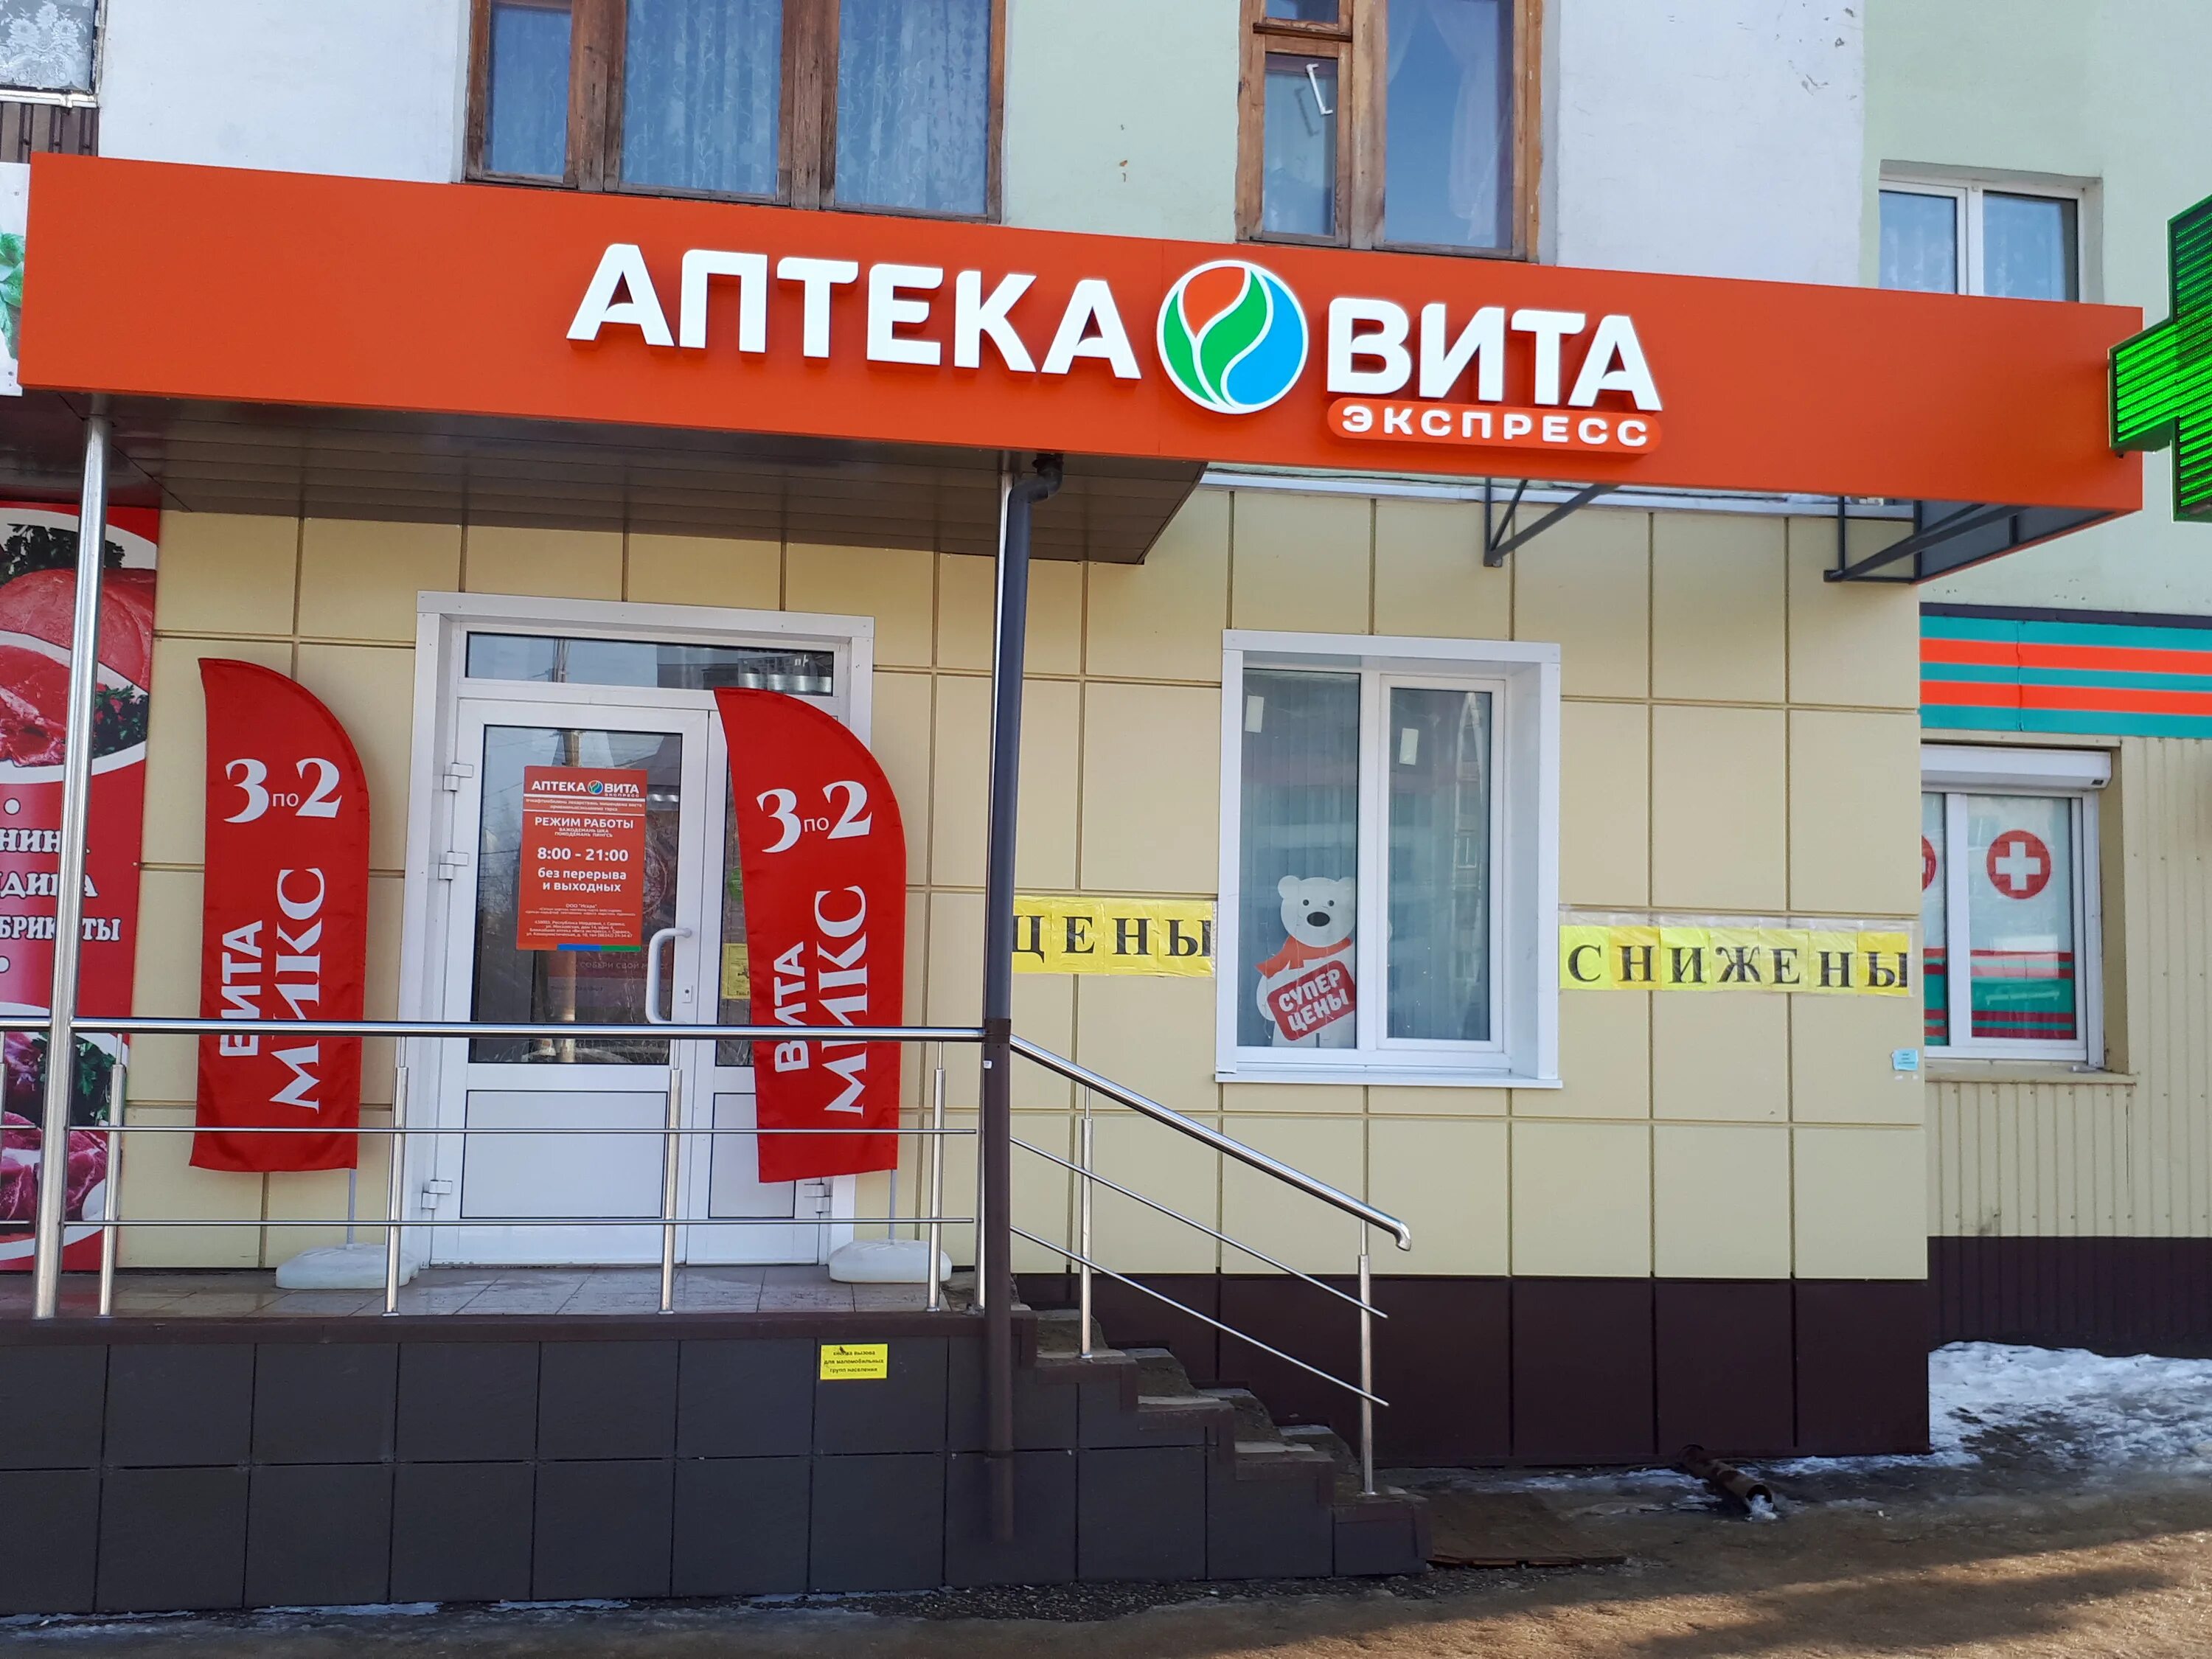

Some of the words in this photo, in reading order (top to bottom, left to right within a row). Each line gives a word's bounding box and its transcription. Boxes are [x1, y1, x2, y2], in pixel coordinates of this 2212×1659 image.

[566, 243, 1142, 380] АПТЕКА
[1326, 297, 1663, 411] ВИТА
[1341, 405, 1649, 447] ЭКСПРЕСС
[223, 758, 269, 824] 3
[272, 790, 299, 808] по
[295, 757, 343, 818] 2
[531, 780, 587, 793] АПТЕКА
[604, 782, 640, 794] ВИТА
[535, 816, 581, 827] РЕЖИМ
[583, 818, 634, 829] РАБОТЫ
[757, 787, 802, 854] 3
[804, 816, 830, 833] по
[821, 780, 873, 840] 2
[537, 846, 571, 860] 8:00
[585, 849, 629, 862] 21:00
[538, 867, 560, 879] без
[563, 870, 627, 881] перерыва
[542, 882, 550, 890] и
[553, 883, 622, 894] выходных
[1012, 915, 1212, 964] ЦЕНЫ
[219, 919, 264, 1058] ВИТА
[1567, 943, 1908, 989] СНИЖЕНЫ
[268, 867, 326, 1115] МИКС
[773, 941, 810, 1074] ВИТА
[814, 885, 869, 1119] МИКС
[1279, 969, 1340, 1012] СУПЕР
[1287, 988, 1349, 1032] ЦЕНЫ
